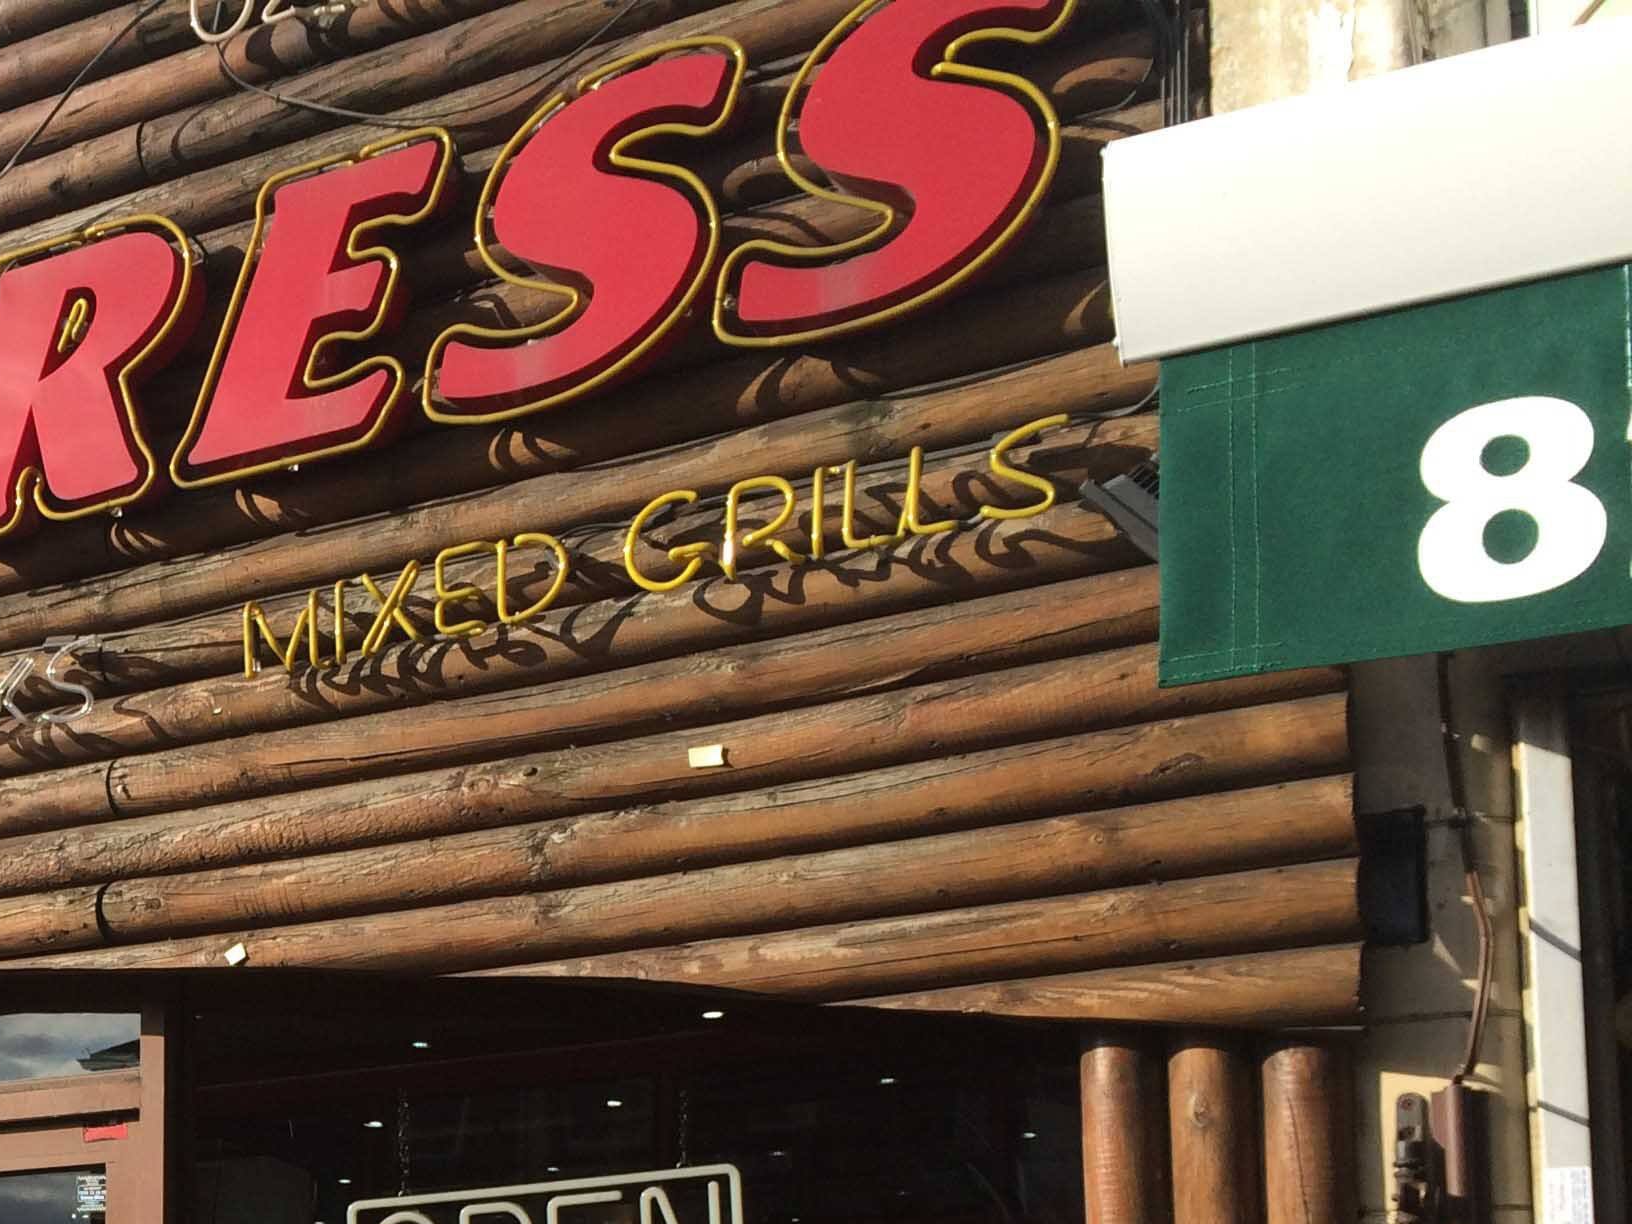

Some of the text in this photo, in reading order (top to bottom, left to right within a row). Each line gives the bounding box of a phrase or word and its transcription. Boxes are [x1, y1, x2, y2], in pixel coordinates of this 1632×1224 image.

[243, 414, 1067, 678] MIXED GRILLS
[1418, 396, 1632, 602] 8
